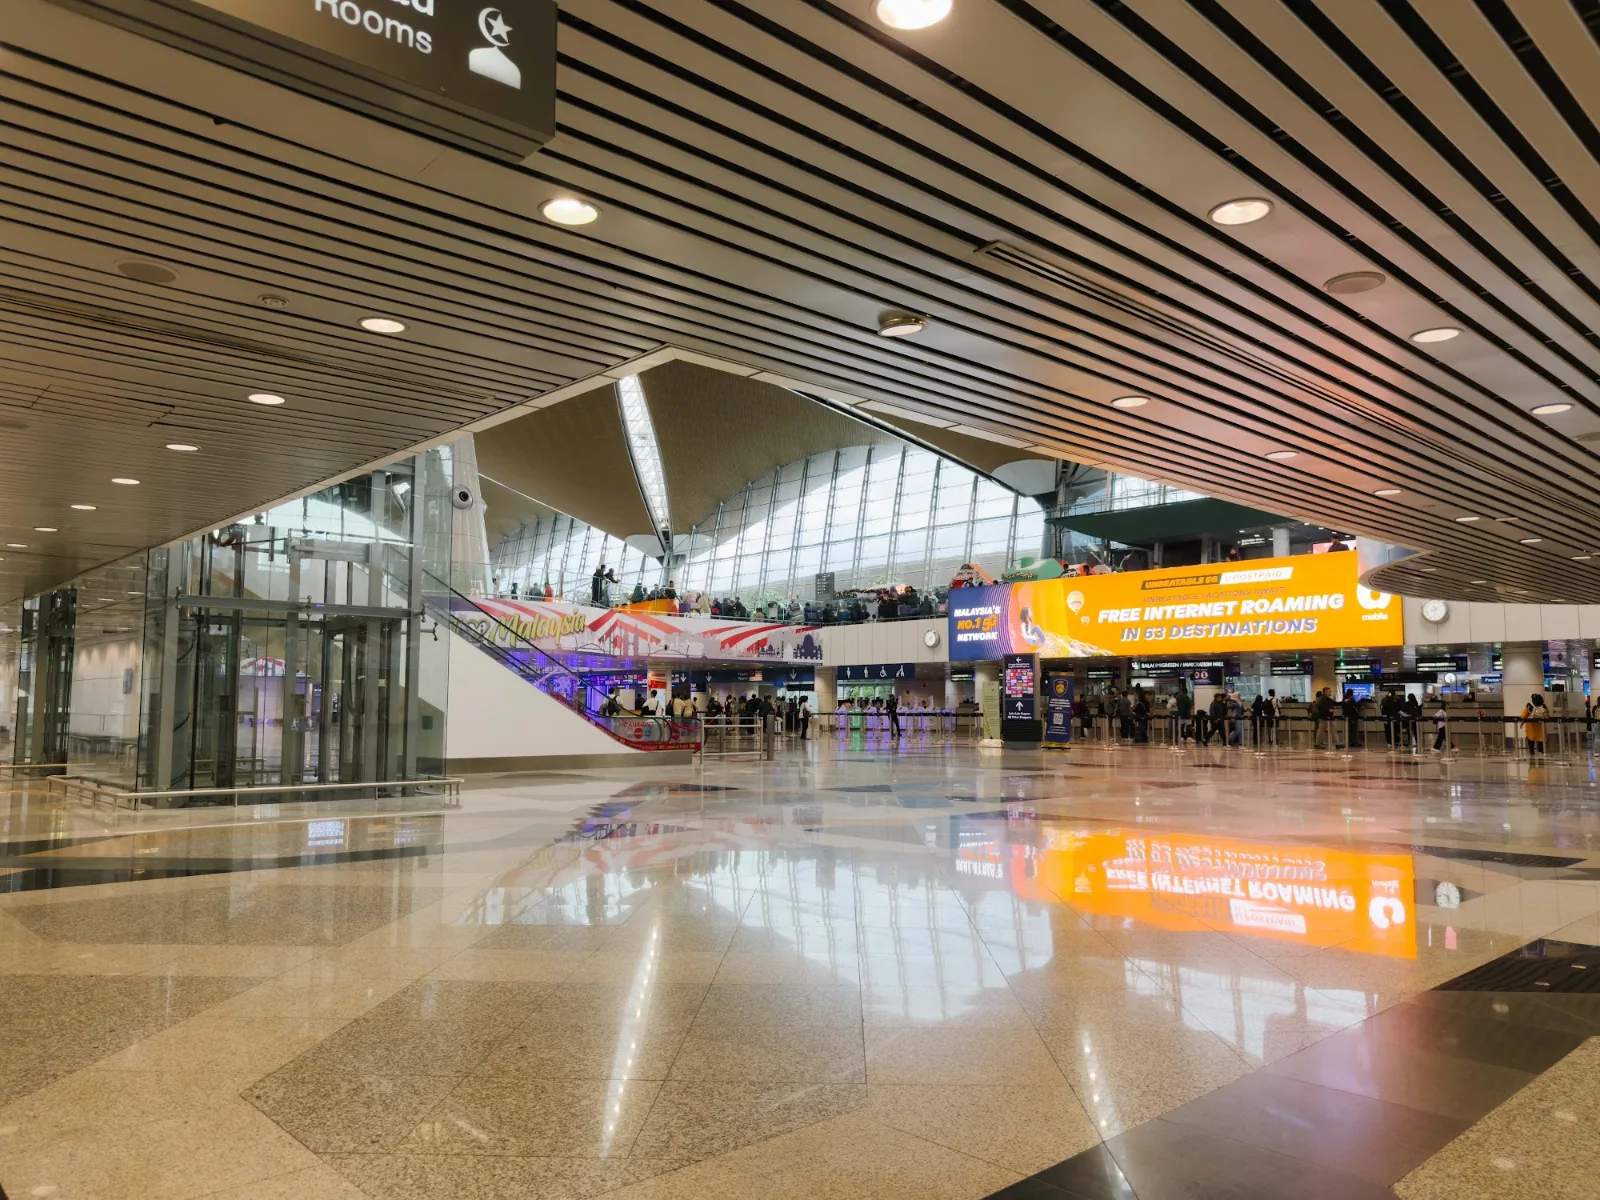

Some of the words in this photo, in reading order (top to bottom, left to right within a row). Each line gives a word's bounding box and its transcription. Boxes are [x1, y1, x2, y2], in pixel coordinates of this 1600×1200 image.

[1144, 576, 1205, 589] UNBEATABLE
[1205, 575, 1218, 584] 5G
[1233, 570, 1283, 581] POSTPAID
[1144, 594, 1199, 603] UNBEATABLE
[1202, 590, 1251, 599] VACATIONS
[1254, 587, 1285, 596] AWAIT
[954, 605, 1001, 617] MALAYSIA'S
[1098, 608, 1141, 624] FREE
[1143, 600, 1238, 621] INTERNET
[1240, 593, 1345, 615] ROAMING
[1361, 612, 1389, 621] mobile
[486, 607, 587, 648] Malaysia
[957, 617, 981, 630] NO.1
[982, 615, 998, 632] 5G
[1120, 626, 1141, 641] IN
[1143, 625, 1167, 640] 63
[1168, 618, 1319, 640] DESTINATIONS
[957, 632, 999, 642] NETWORK
